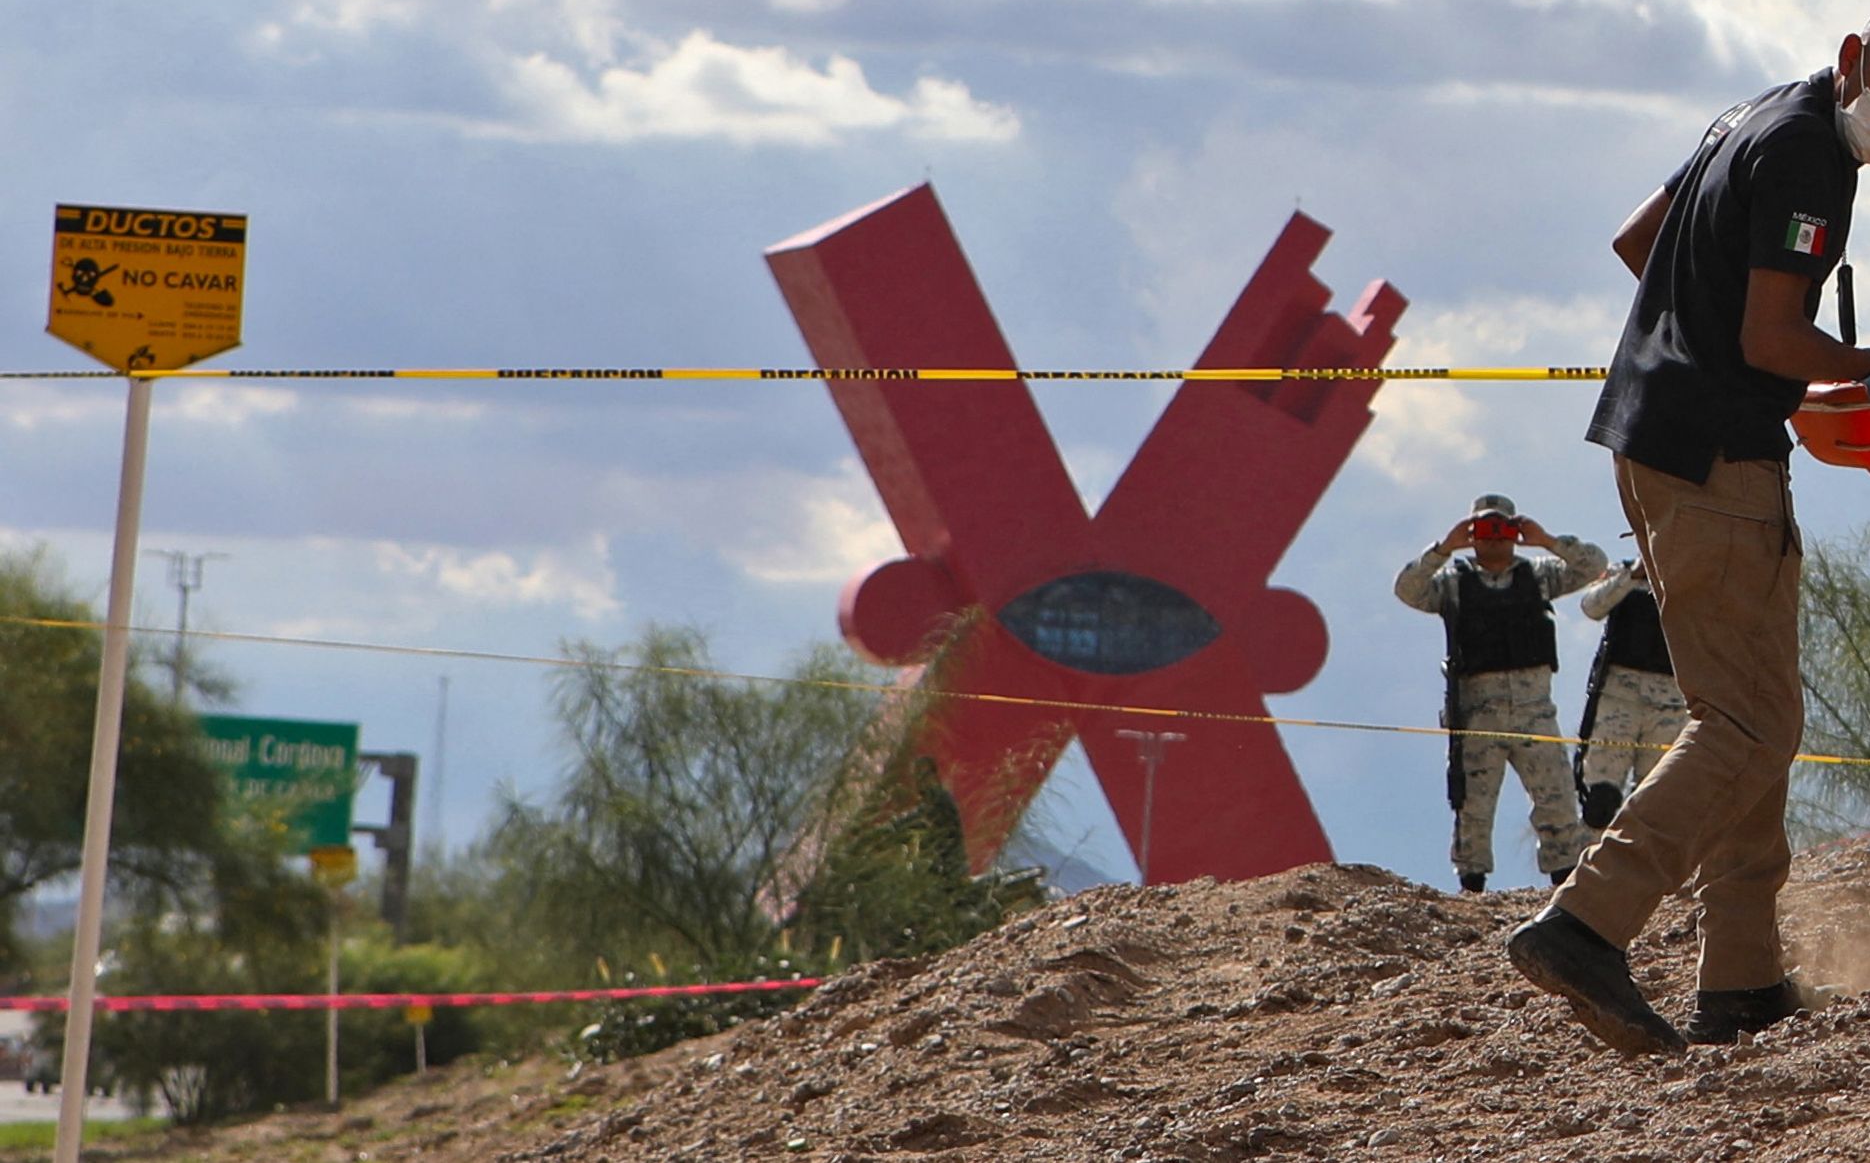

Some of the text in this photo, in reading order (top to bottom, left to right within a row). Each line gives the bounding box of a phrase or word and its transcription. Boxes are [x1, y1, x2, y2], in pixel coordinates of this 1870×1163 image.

[85, 210, 217, 238] DUCTOS
[61, 238, 75, 249] DE
[80, 239, 107, 250] ALTA
[166, 244, 195, 258] BAJO
[200, 245, 237, 258] TIERRA
[122, 269, 238, 292] NO CAVAR
